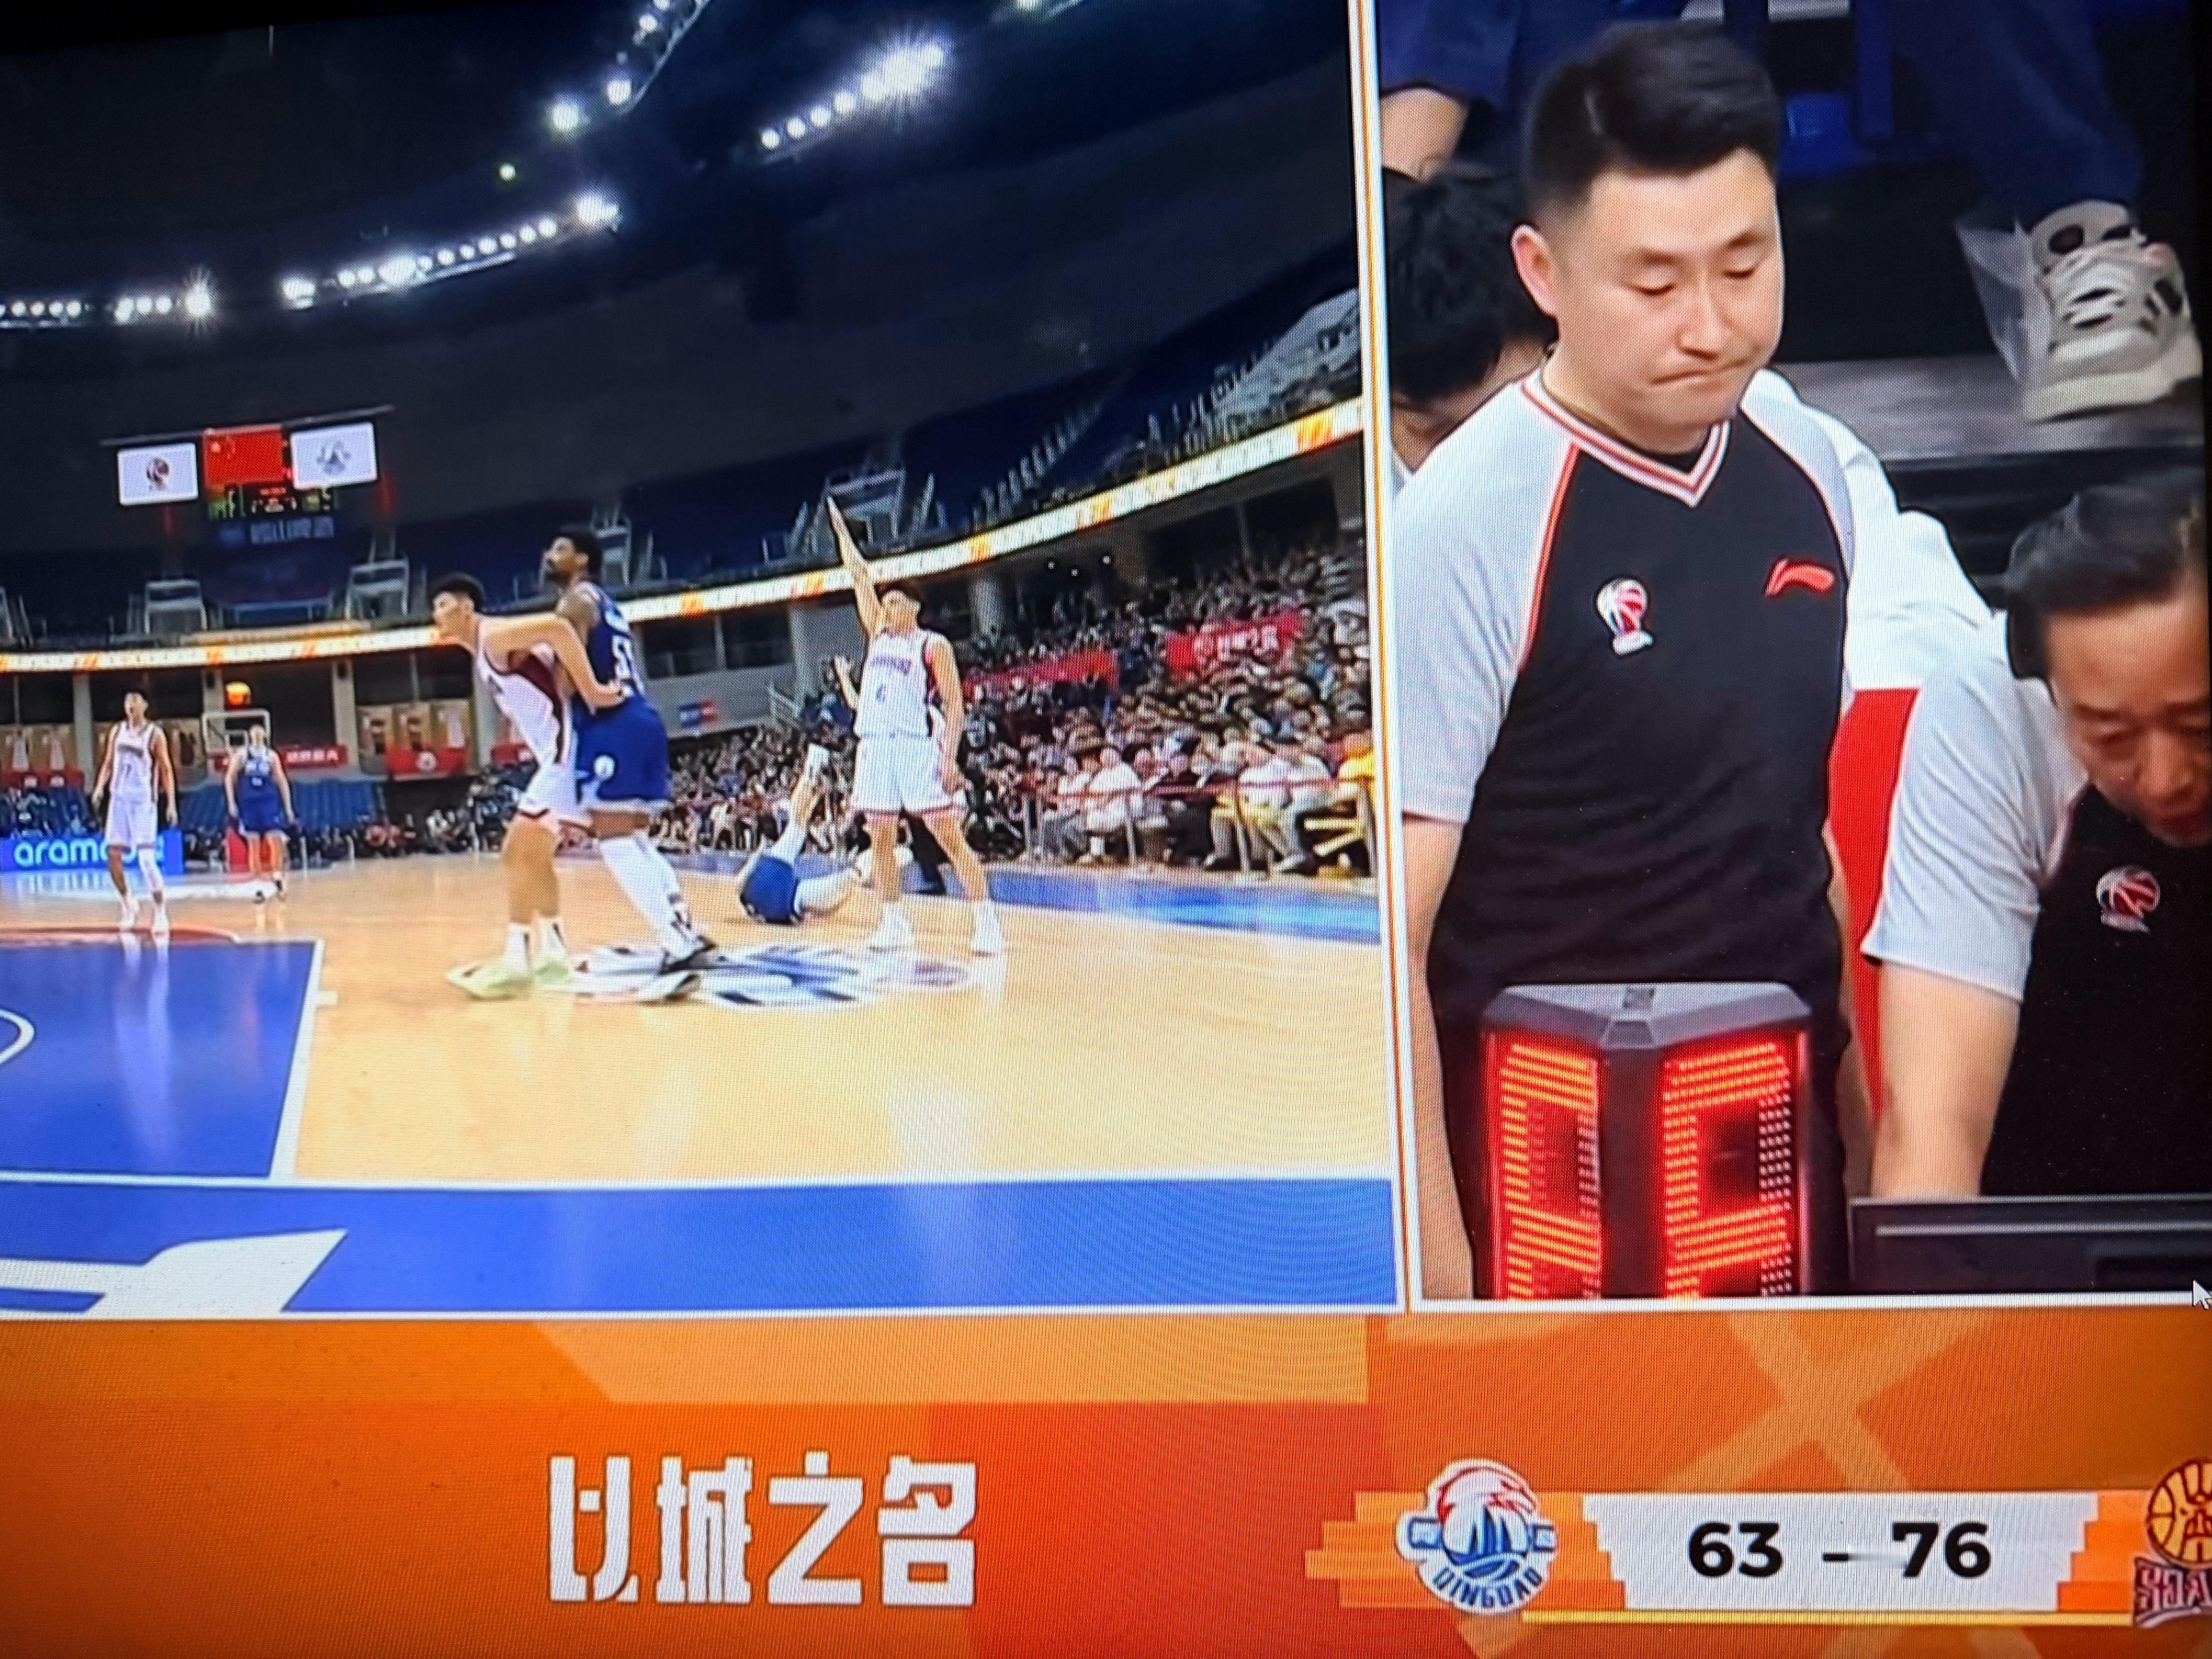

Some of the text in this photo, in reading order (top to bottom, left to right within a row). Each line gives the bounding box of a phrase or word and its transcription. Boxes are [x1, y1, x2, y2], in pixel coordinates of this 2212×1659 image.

[548, 1450, 977, 1606] 以城之名
[1688, 1522, 1783, 1578] 63
[1892, 1521, 1991, 1578] 76
[1432, 1566, 1544, 1609] QINGDAO
